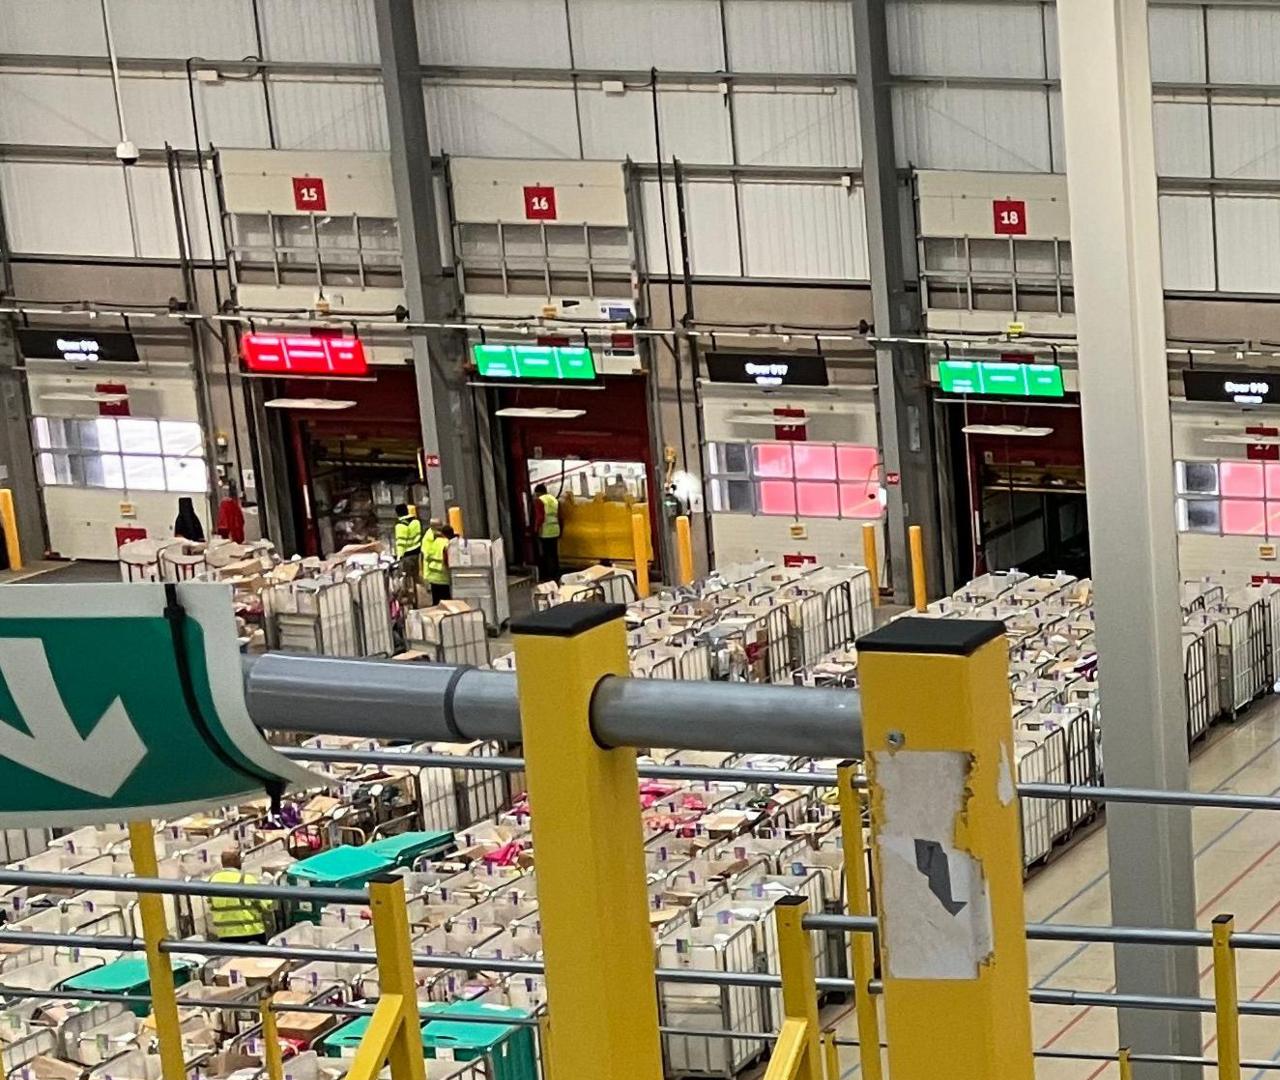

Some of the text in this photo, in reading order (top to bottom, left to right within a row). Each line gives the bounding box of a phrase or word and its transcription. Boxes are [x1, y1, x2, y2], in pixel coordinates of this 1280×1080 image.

[301, 187, 318, 201] 15
[531, 196, 549, 211] 16
[1000, 211, 1018, 225] 18
